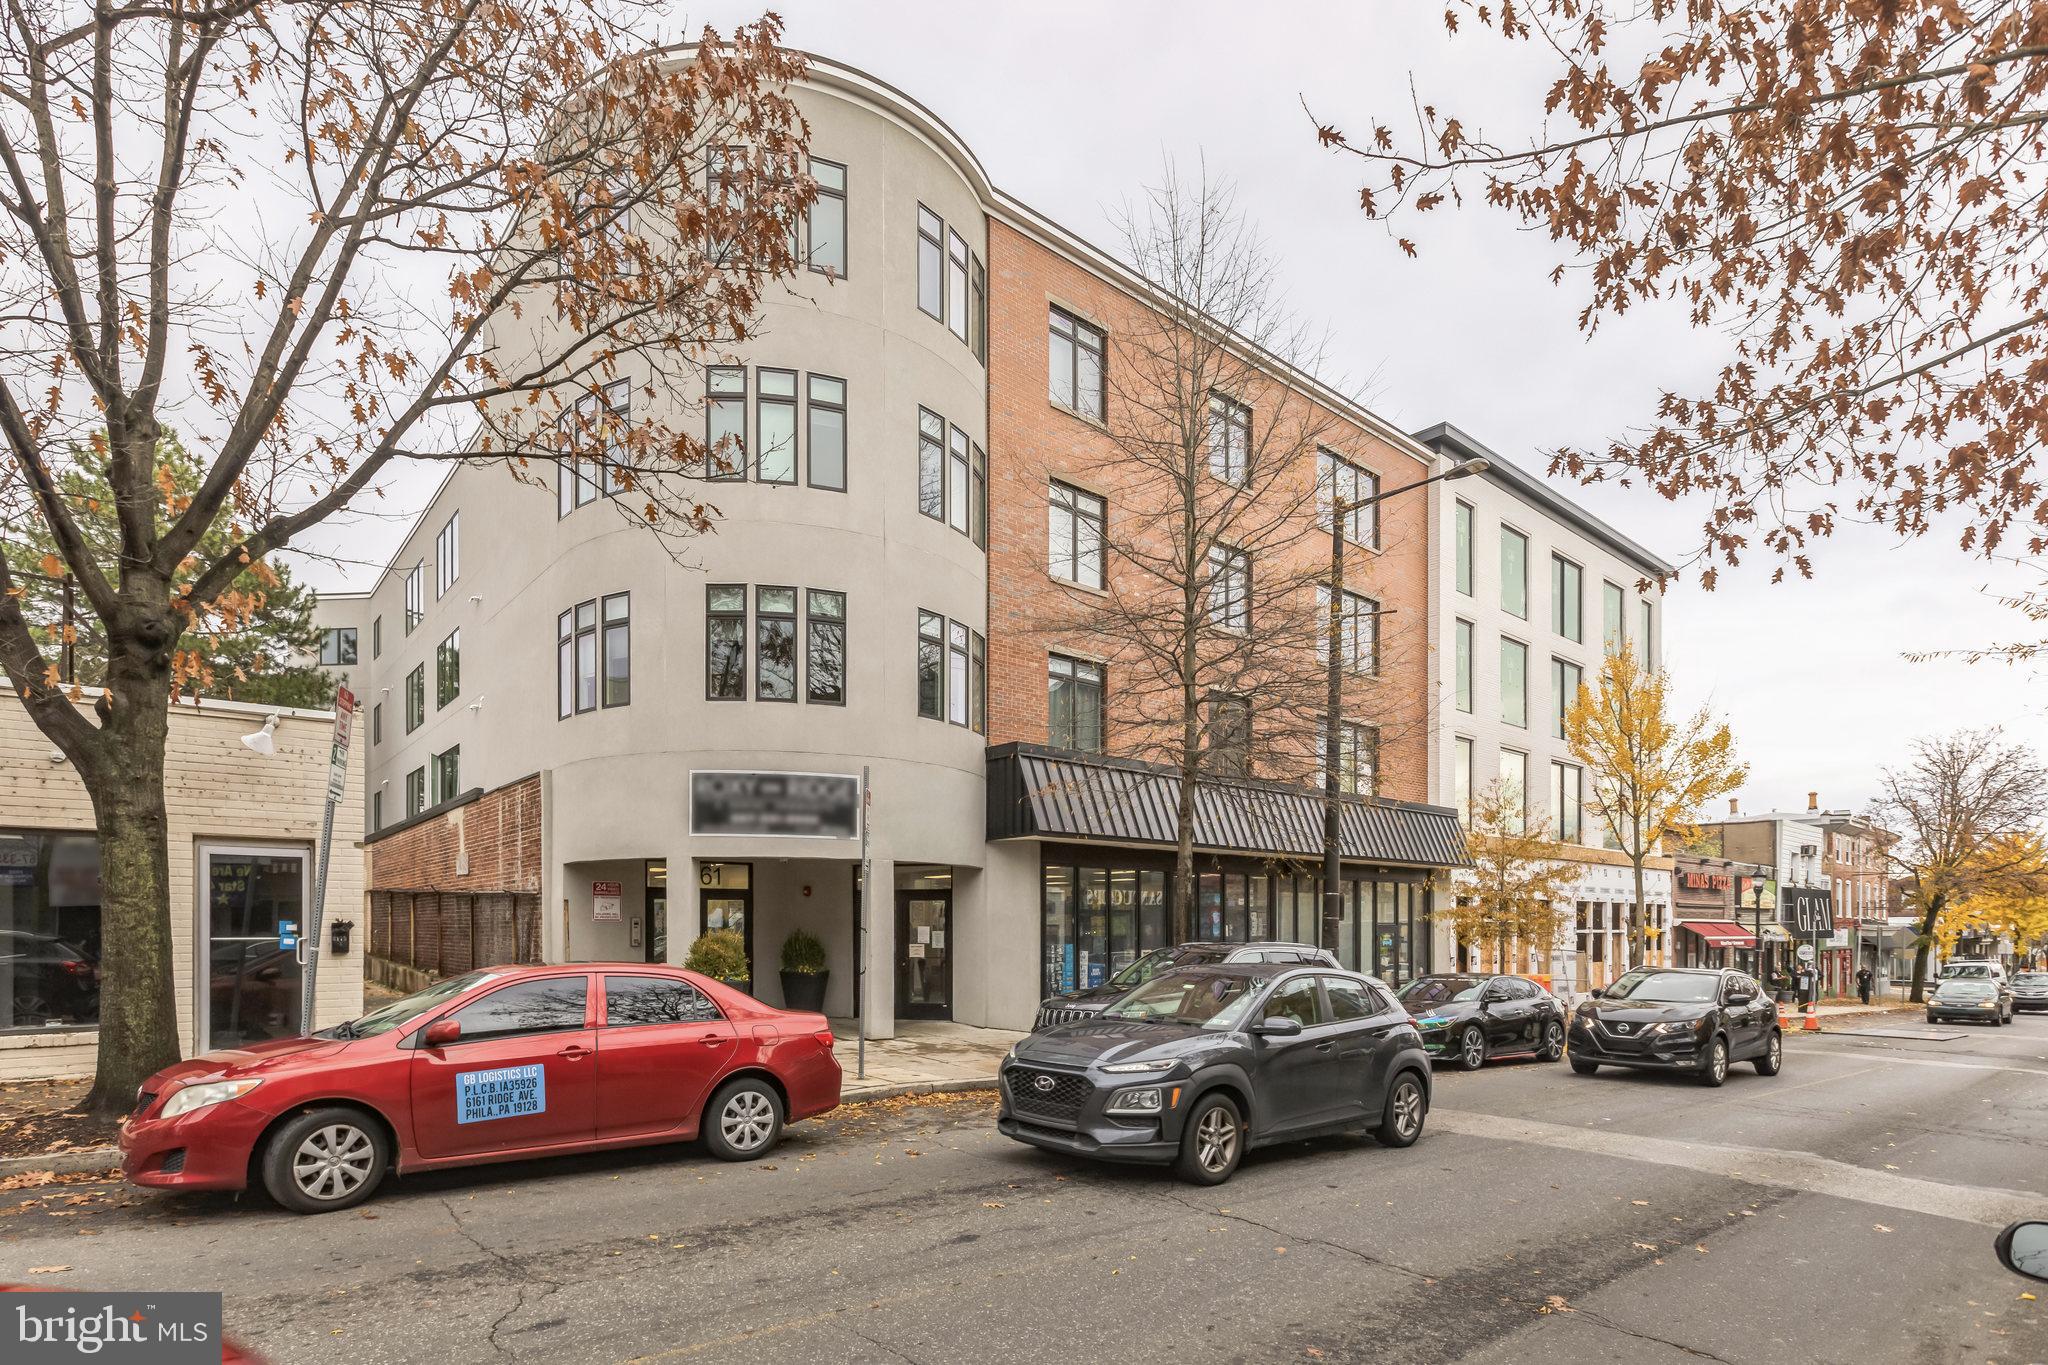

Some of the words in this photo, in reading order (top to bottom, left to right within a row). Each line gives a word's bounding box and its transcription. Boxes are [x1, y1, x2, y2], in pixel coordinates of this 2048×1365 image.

[595, 883, 606, 891] 24
[463, 1074, 476, 1085] GB
[478, 1069, 521, 1084] LOGISTICS
[523, 1066, 537, 1078] LLC
[499, 1078, 537, 1092] IA35926
[465, 1096, 485, 1108] 6161
[488, 1092, 514, 1105] RIDGE
[518, 1089, 537, 1101] AVE.
[498, 1104, 510, 1114] PA
[513, 1100, 537, 1113] 19128
